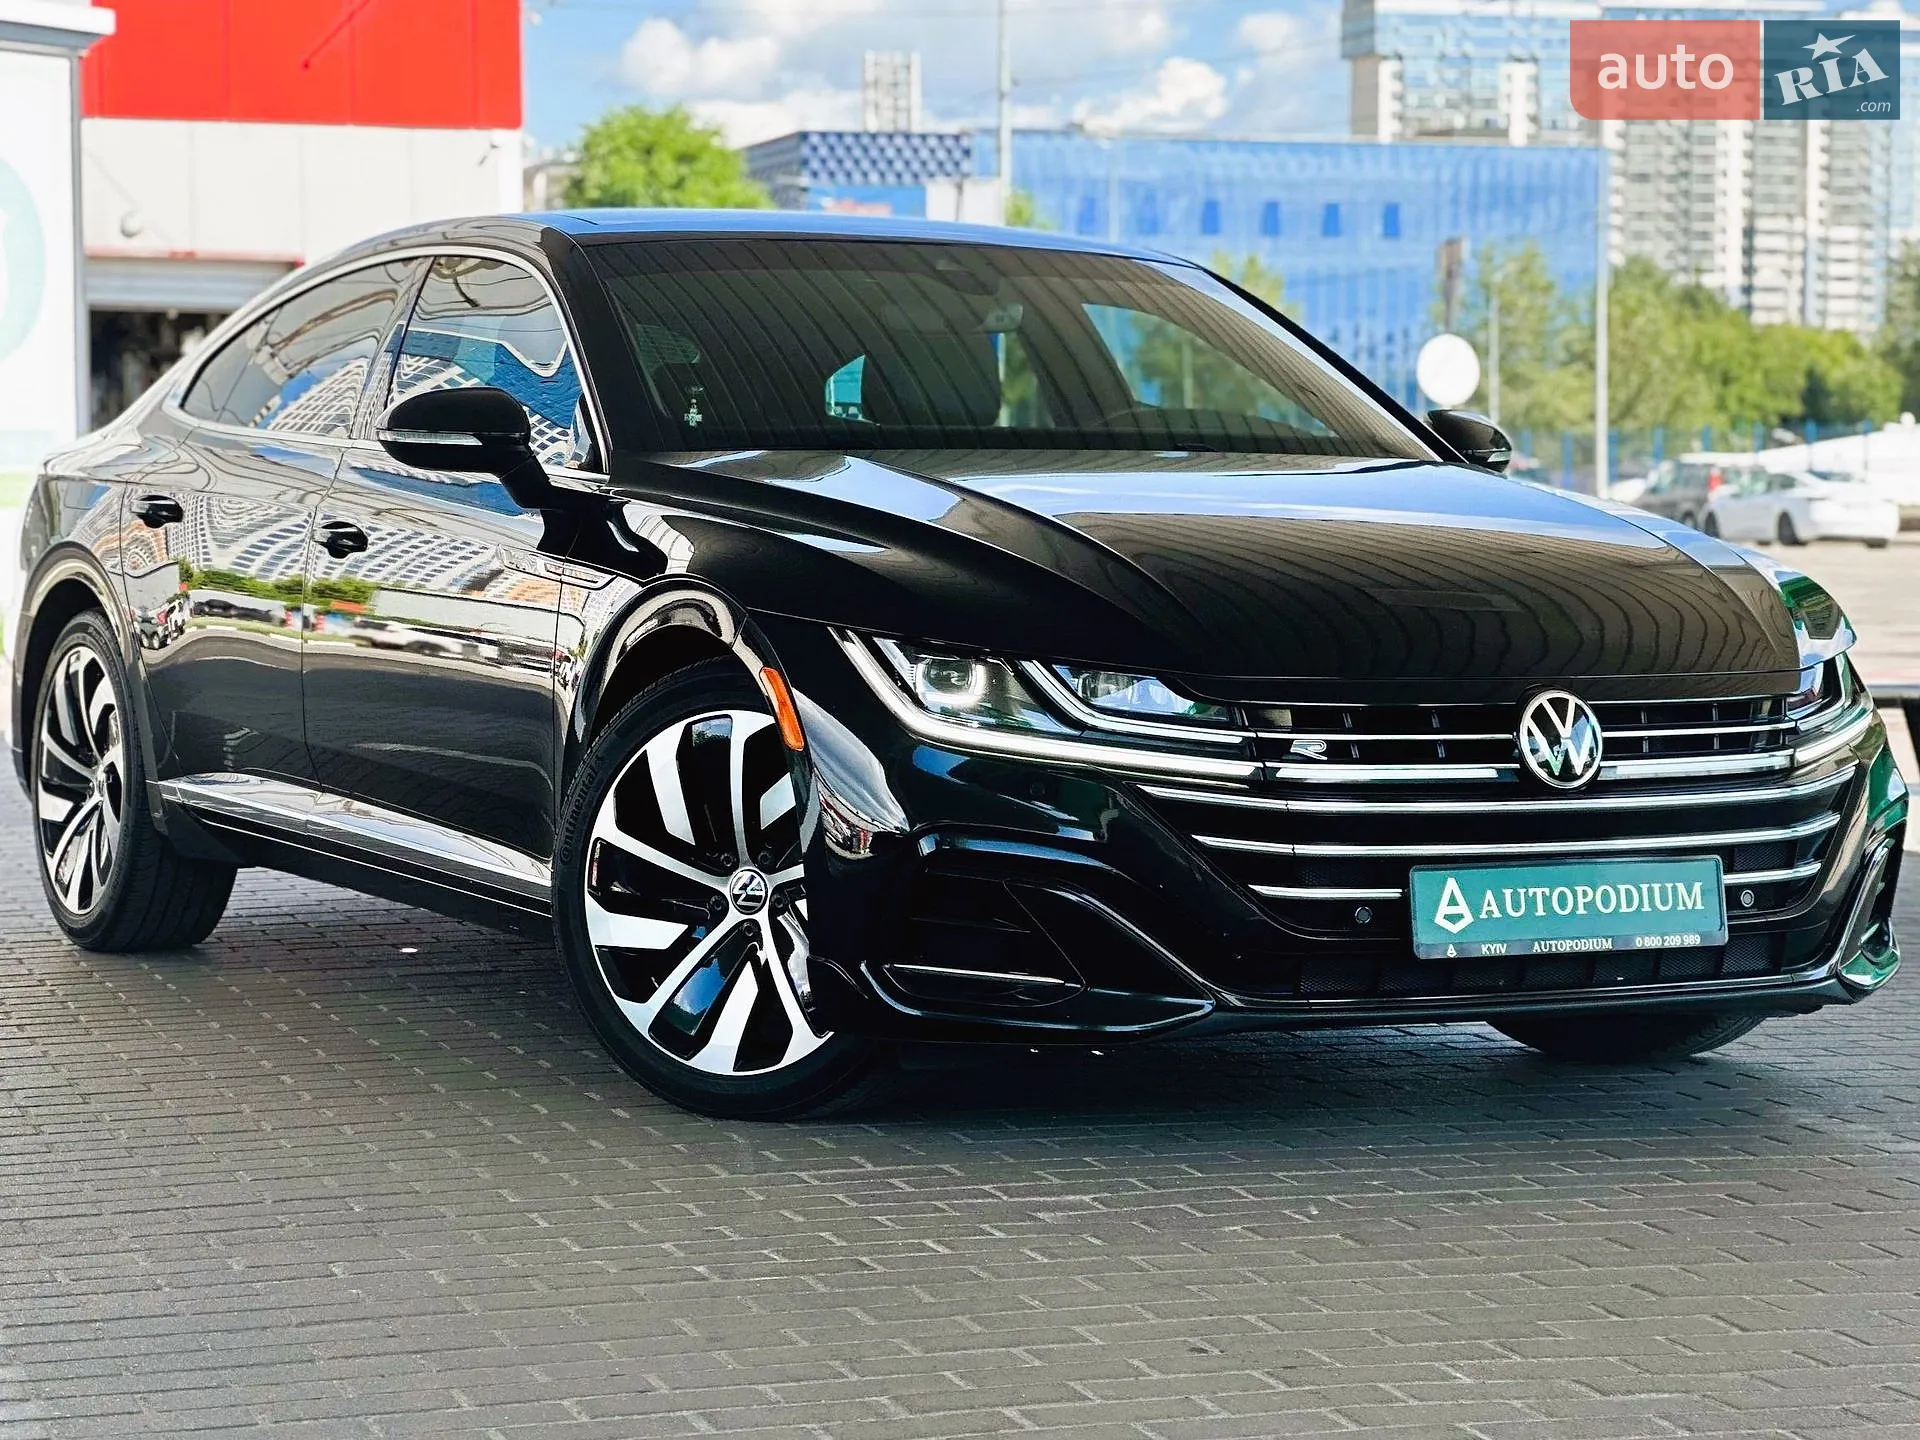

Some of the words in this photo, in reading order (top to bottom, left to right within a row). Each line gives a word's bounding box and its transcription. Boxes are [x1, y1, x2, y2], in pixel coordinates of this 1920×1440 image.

[1479, 882, 1705, 919] AUTOPODIUM
[1481, 943, 1507, 955] KYIV
[1532, 938, 1613, 952] AUTOPODIUM
[1635, 936, 1643, 947] 0
[1644, 935, 1662, 947] 800
[1664, 934, 1681, 946] 209
[1683, 934, 1701, 945] 989
